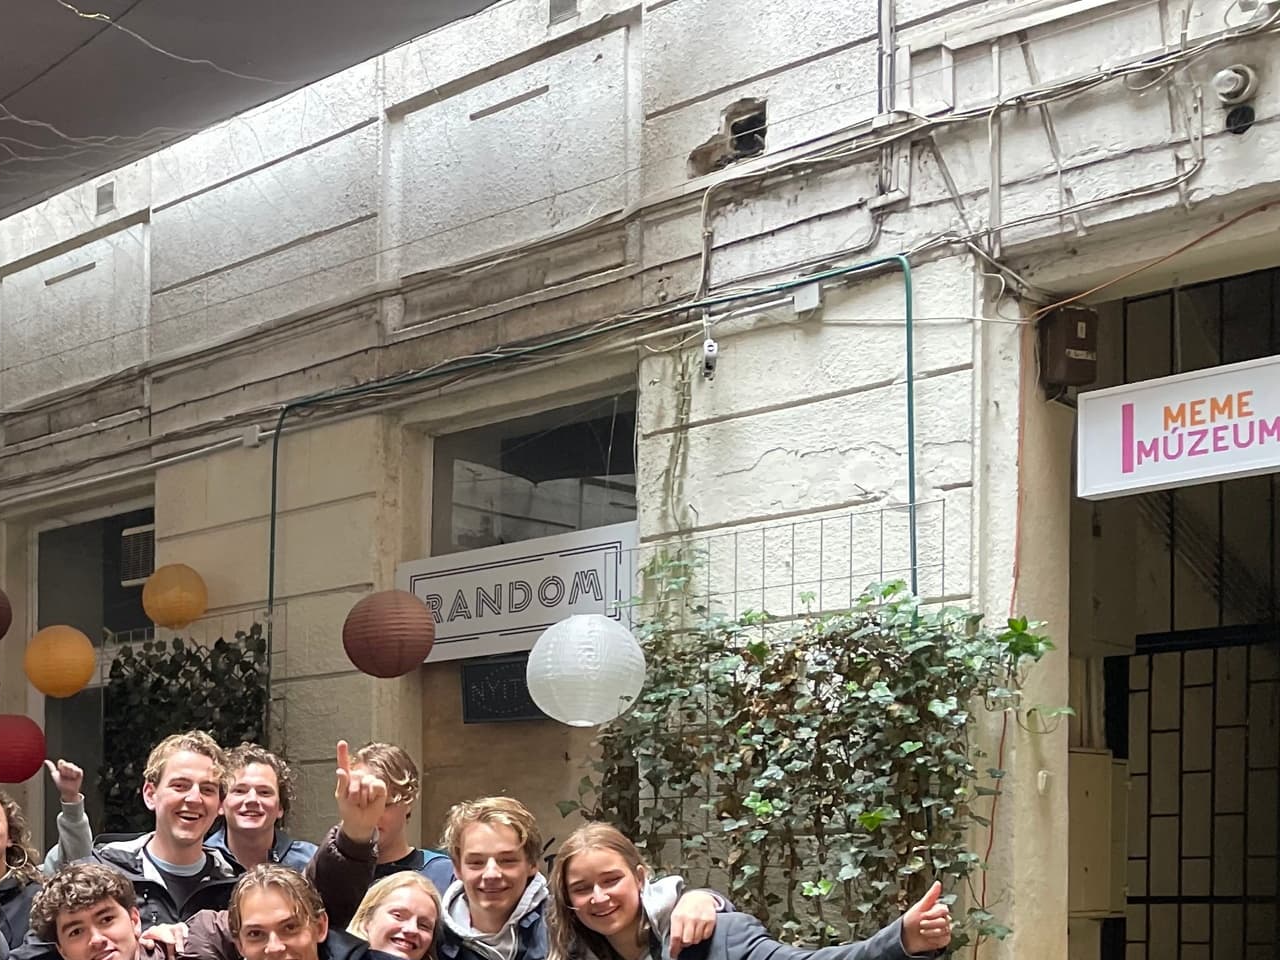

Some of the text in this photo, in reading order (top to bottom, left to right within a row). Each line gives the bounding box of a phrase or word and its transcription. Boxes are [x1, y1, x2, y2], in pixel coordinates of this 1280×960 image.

[1163, 390, 1254, 431] MEME
[1136, 416, 1280, 465] MÚZEUM
[426, 569, 603, 624] RANDOM
